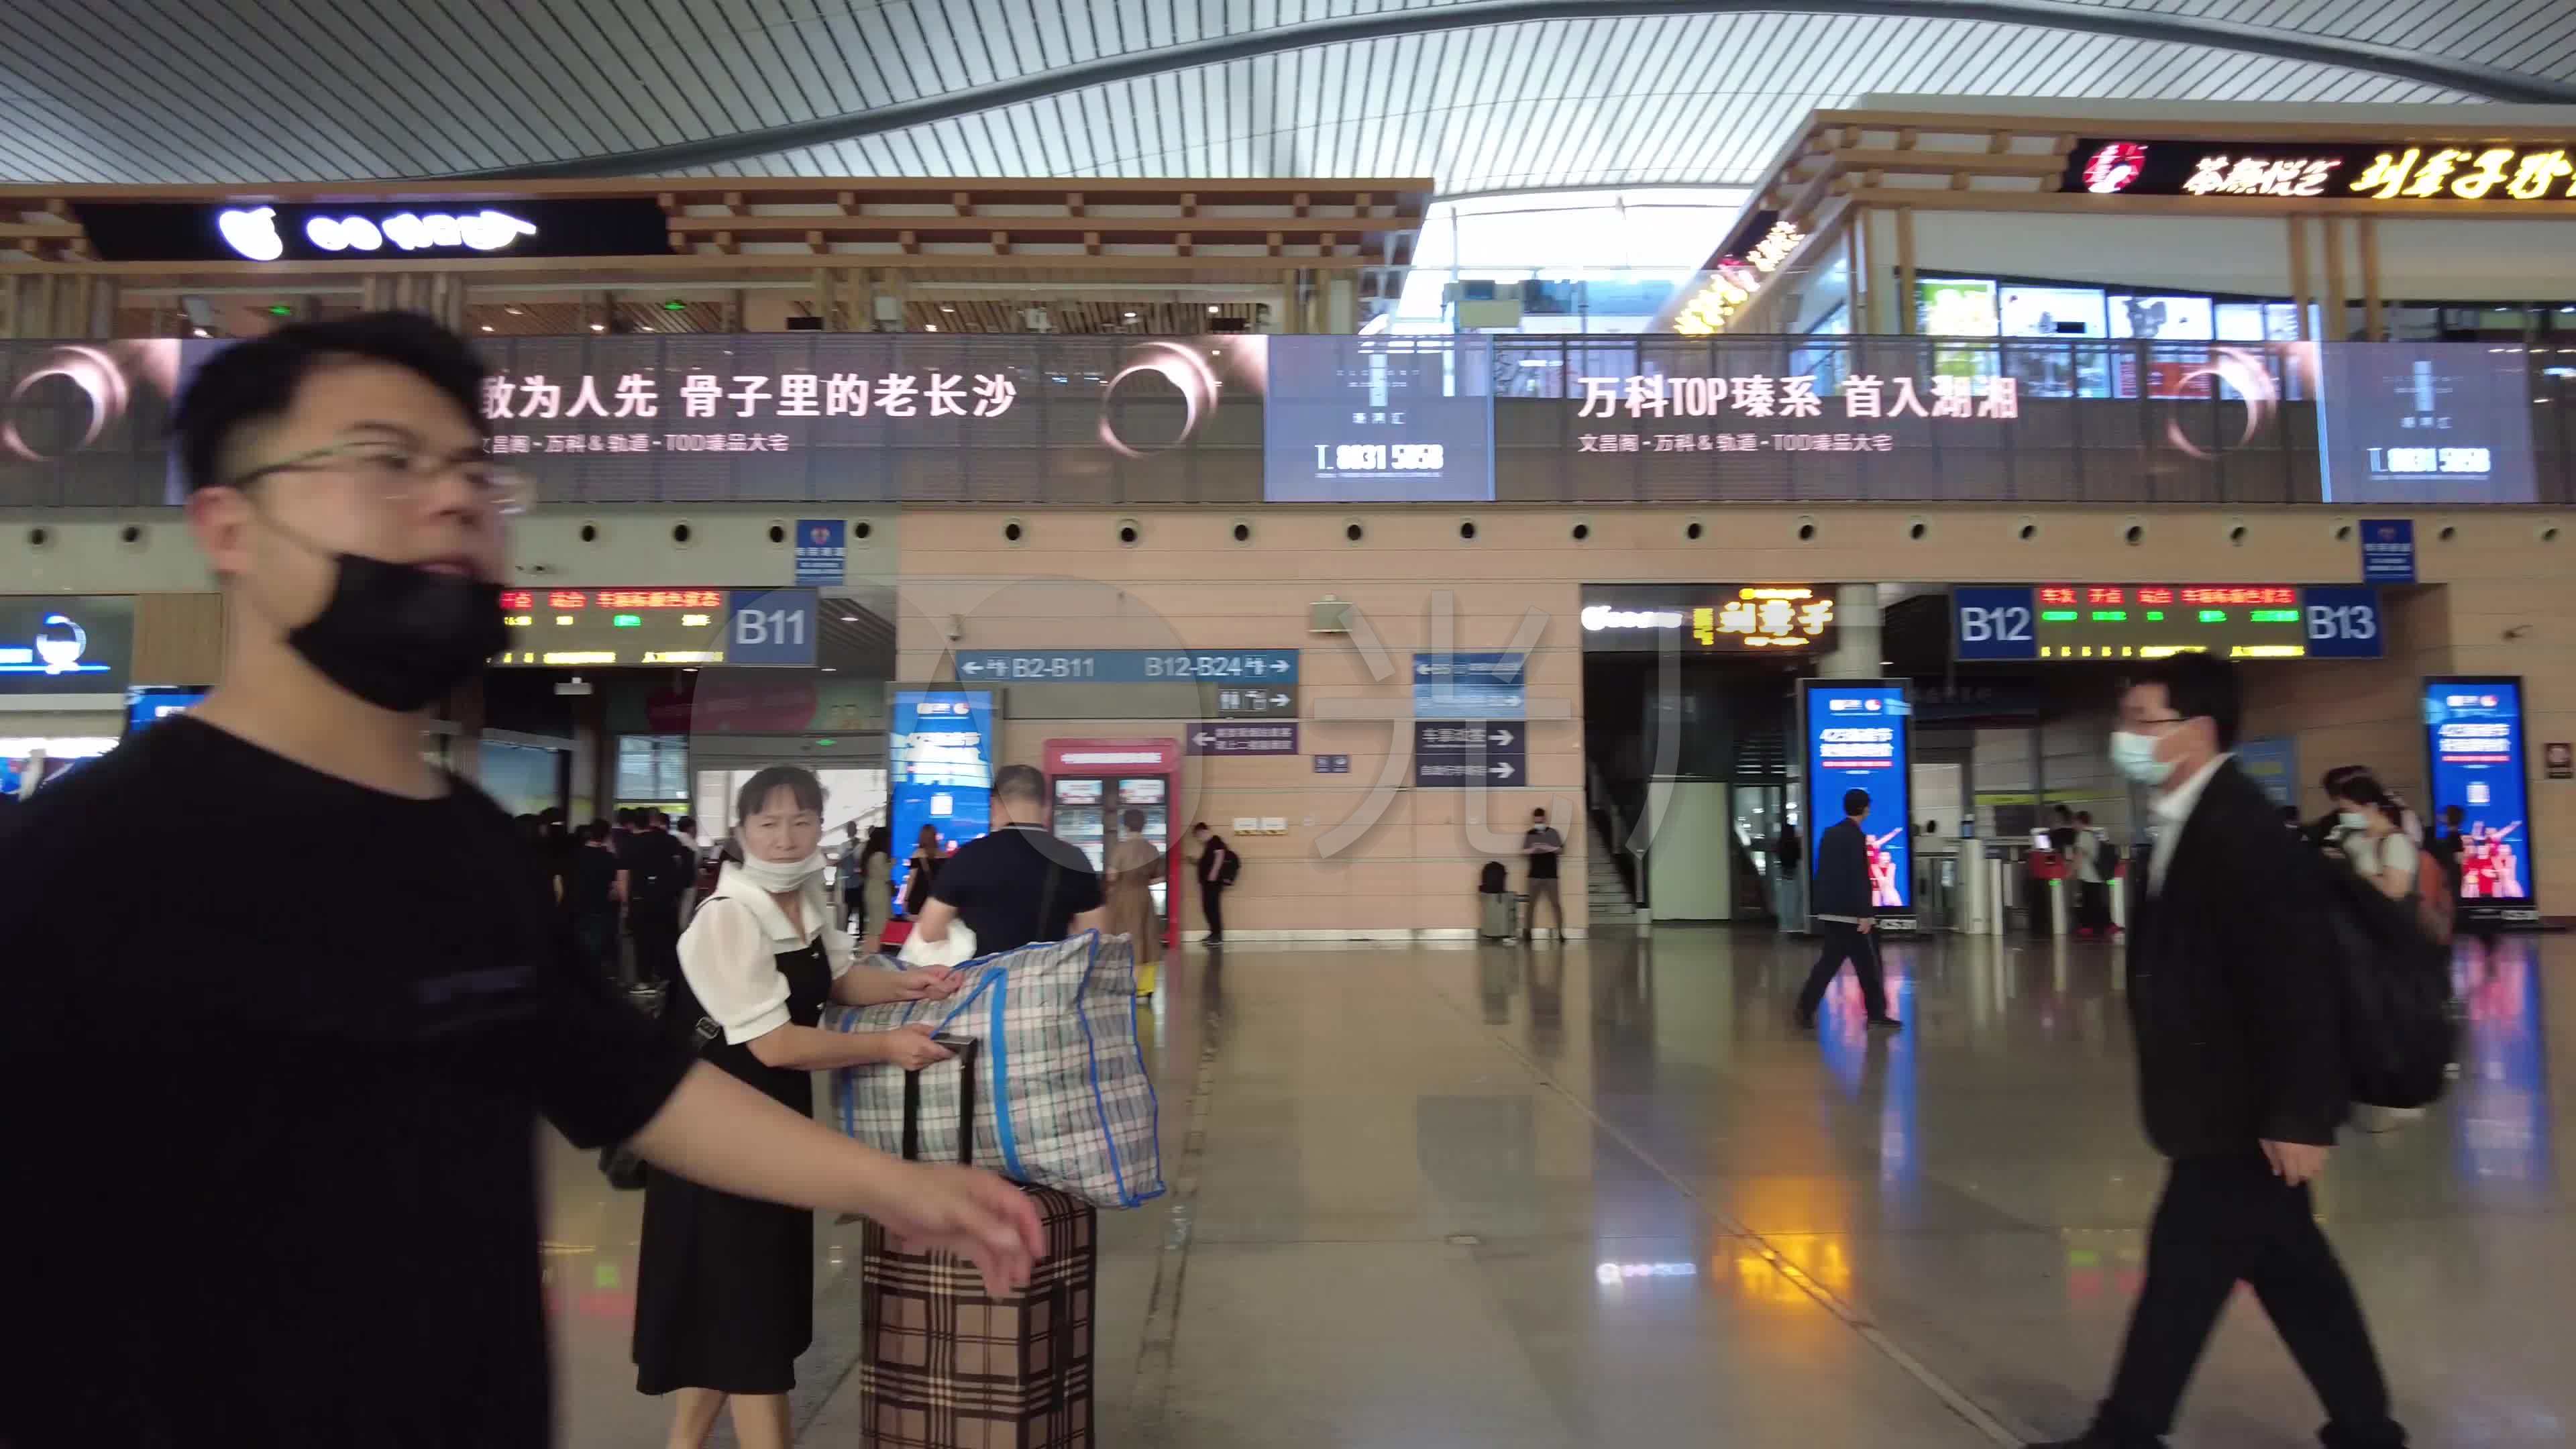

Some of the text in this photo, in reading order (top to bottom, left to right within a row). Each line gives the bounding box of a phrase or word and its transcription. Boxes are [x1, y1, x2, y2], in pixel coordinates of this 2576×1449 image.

[680, 373, 1017, 417] 骨子里的老长沙
[737, 609, 805, 645] B11
[1961, 606, 2033, 642] B12
[2307, 605, 2377, 640] B13
[1012, 656, 1243, 678] B2-B11 B12-B24
